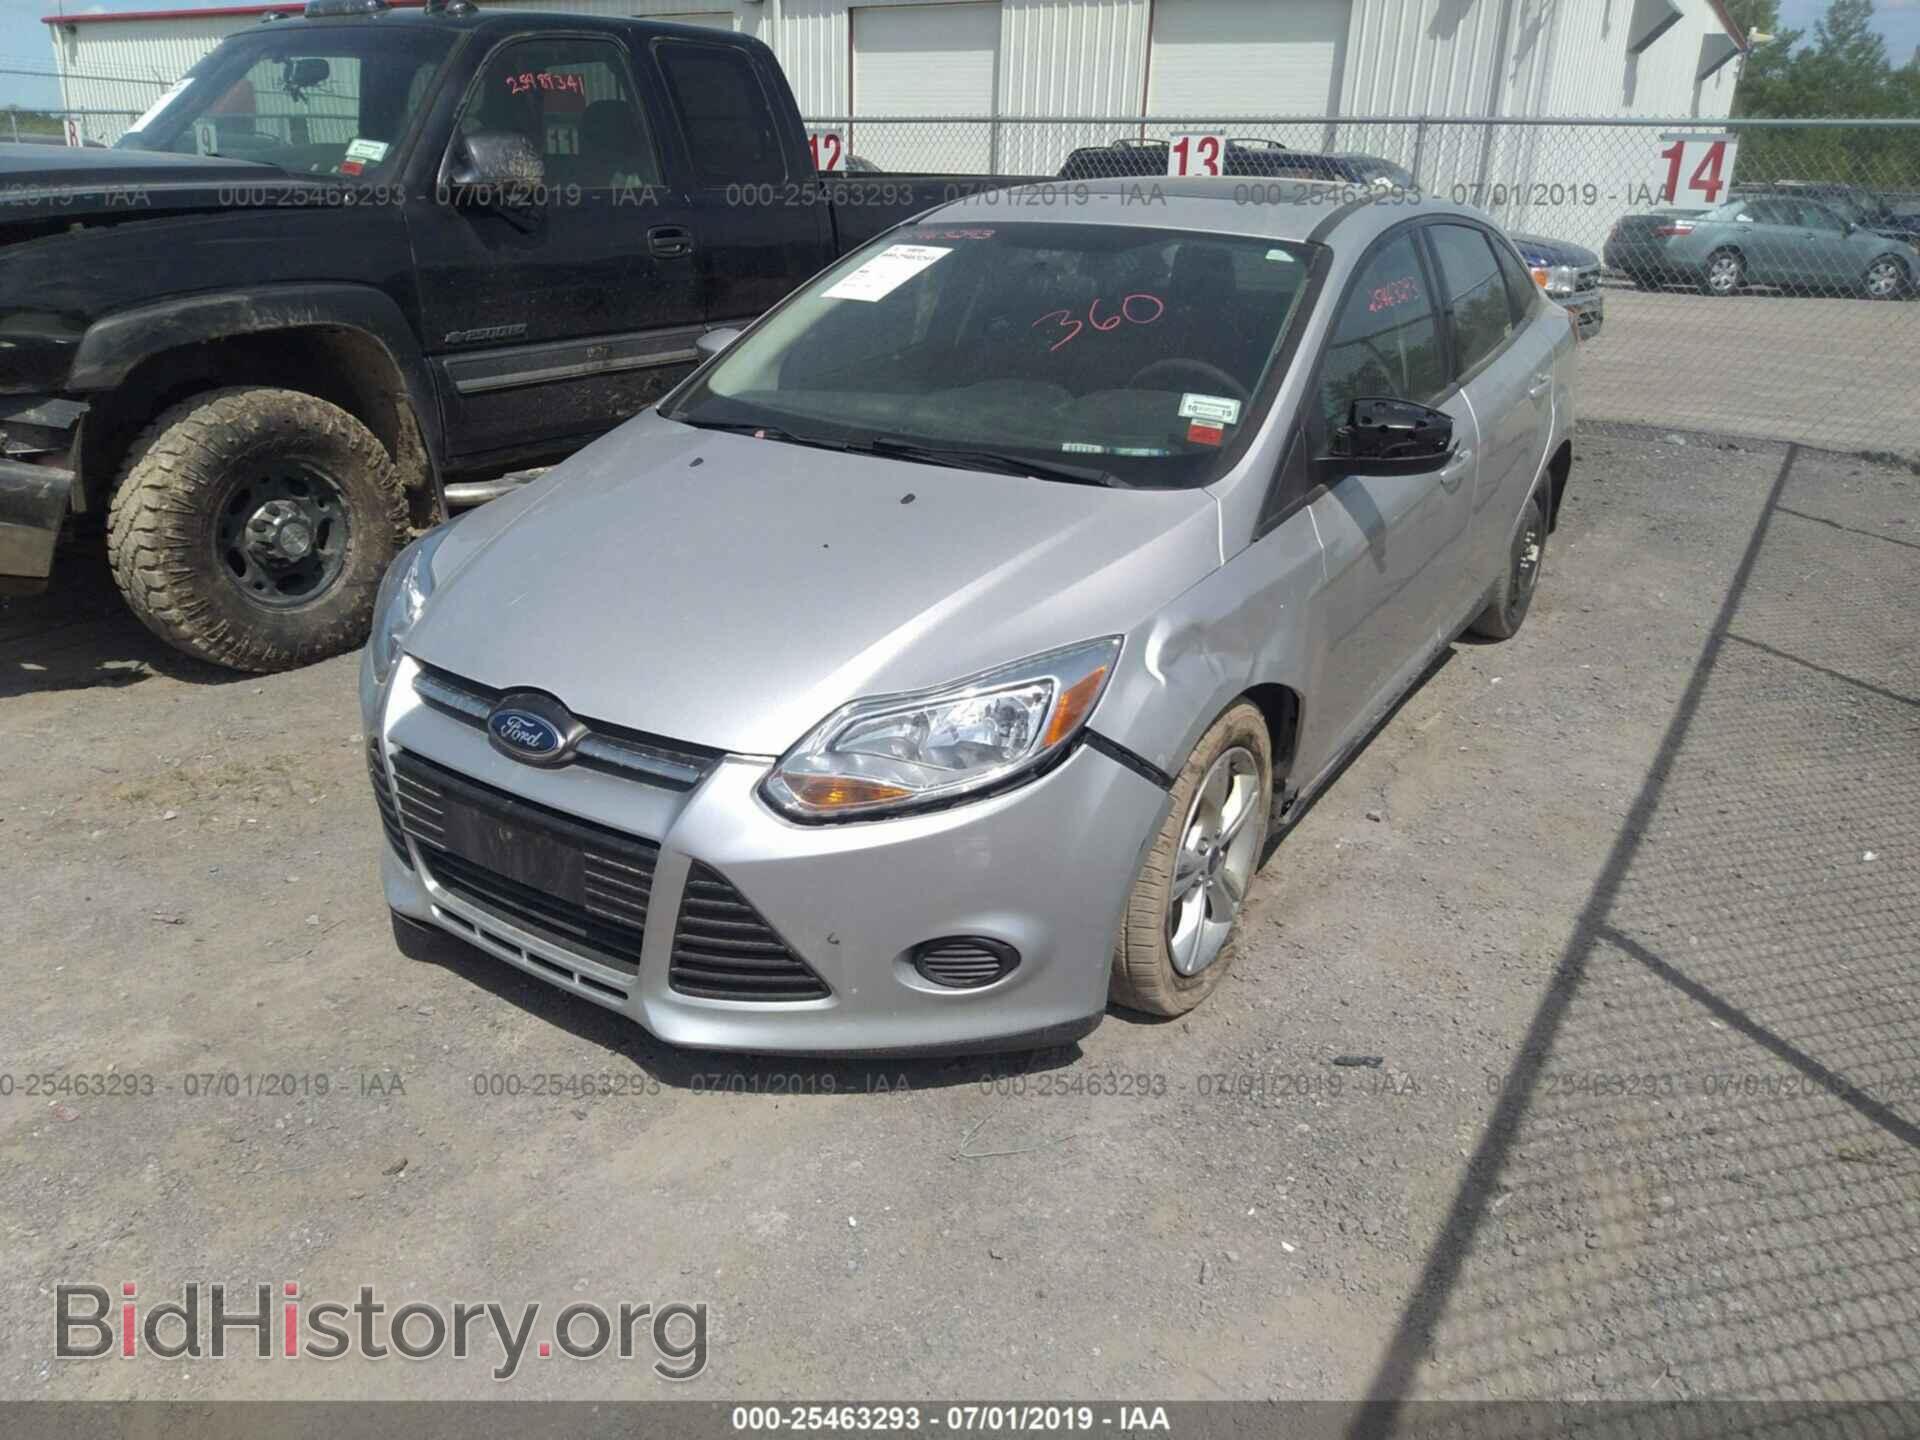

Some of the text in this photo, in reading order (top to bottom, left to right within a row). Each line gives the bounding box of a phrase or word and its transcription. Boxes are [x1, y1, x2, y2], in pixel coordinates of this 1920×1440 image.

[808, 133, 841, 171] 12
[1173, 136, 1219, 176] 13
[1661, 140, 1728, 204] 14
[1031, 293, 1164, 352] 360
[501, 715, 544, 748] Ford
